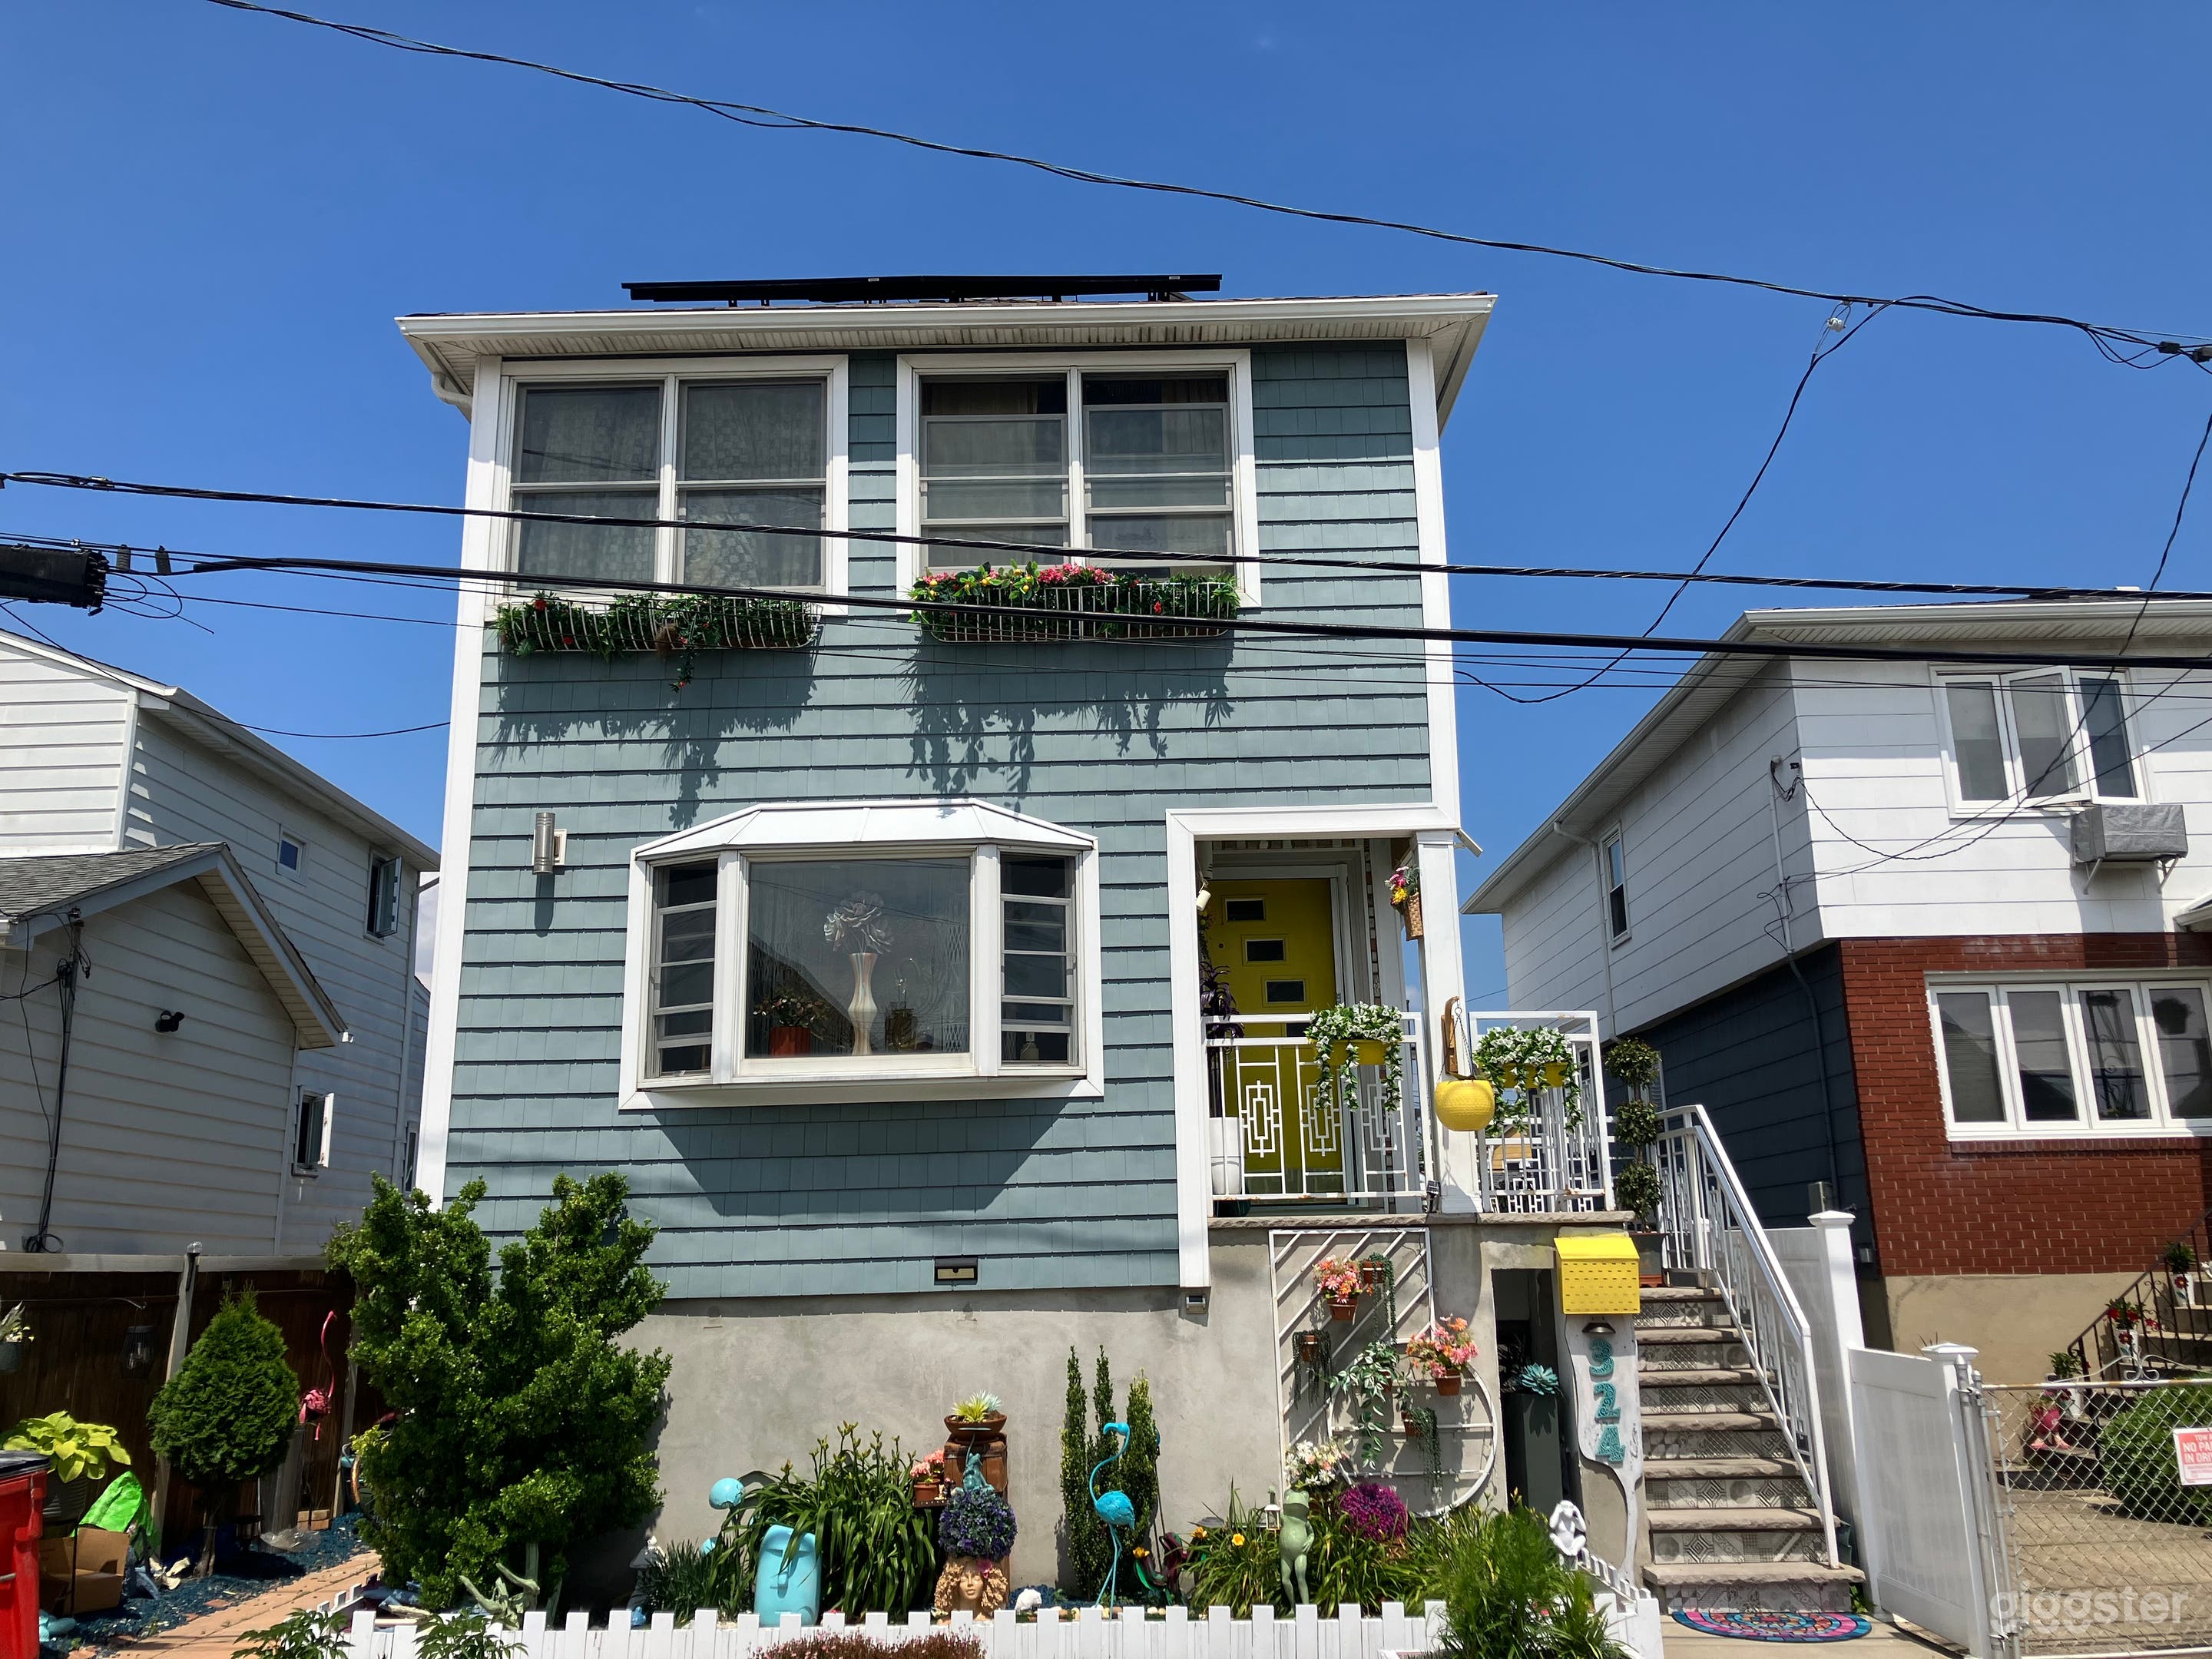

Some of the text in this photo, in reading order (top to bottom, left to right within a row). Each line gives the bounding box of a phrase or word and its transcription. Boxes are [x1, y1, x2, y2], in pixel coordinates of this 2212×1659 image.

[1589, 1339, 1625, 1462] 324
[2183, 1441, 2212, 1452] NO PA
[2184, 1452, 2212, 1463] IN DRI
